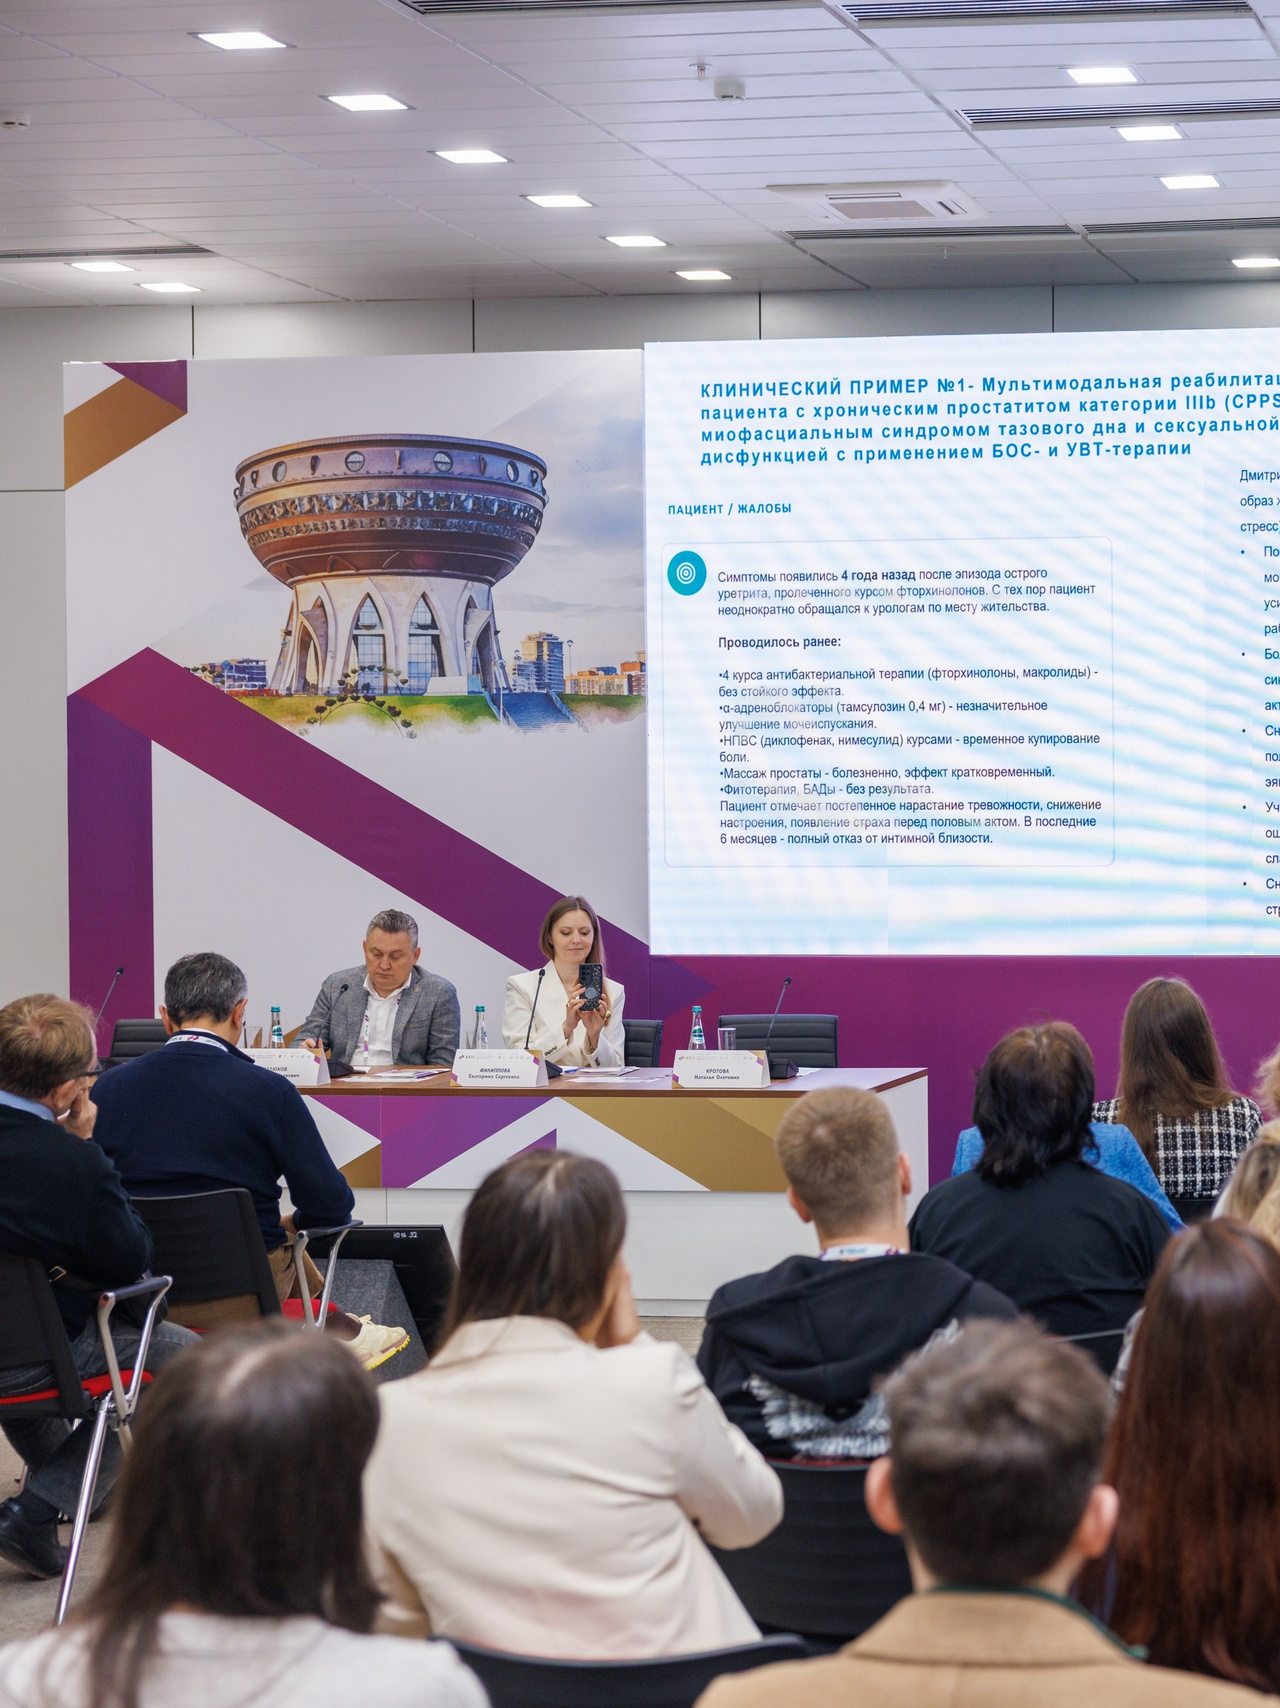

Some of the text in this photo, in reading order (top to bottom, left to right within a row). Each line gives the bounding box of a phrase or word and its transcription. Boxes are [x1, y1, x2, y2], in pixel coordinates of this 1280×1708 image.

[702, 377, 840, 397] КЛИНИЧЕСКИЙ
[850, 379, 928, 394] ПРИМЕР
[938, 378, 973, 393] №1-
[983, 377, 1161, 395] Мультимодальная
[701, 407, 787, 421] пациента
[796, 407, 804, 418] с
[814, 404, 937, 420] хроническим
[947, 402, 1070, 418] простатитом
[1080, 399, 1176, 414] категории
[702, 416, 1278, 444] миофасциальным синдромом тазового дна и сексуальной
[701, 442, 1190, 466] дисфункцией с применением БОС- и УВТ-терапии
[668, 503, 791, 516] ПАЦИЕНТ ЖАЛОБЫ
[718, 570, 1047, 582] Симптомы появились 4 года назад после эпизода острого
[718, 603, 1049, 617] неоднократно обращался к урологам по месту жительства.
[719, 637, 840, 651] Проводилось ранее:
[723, 667, 1090, 683] 4 курса антибактериальной терапии (фторхинолоны, макролиды)
[720, 751, 749, 763] боли.
[724, 766, 1055, 781] Массаж простаты болезненно, эффект кратковременный.
[721, 832, 992, 845] 6 месяцев полный отказ от интимной близости.
